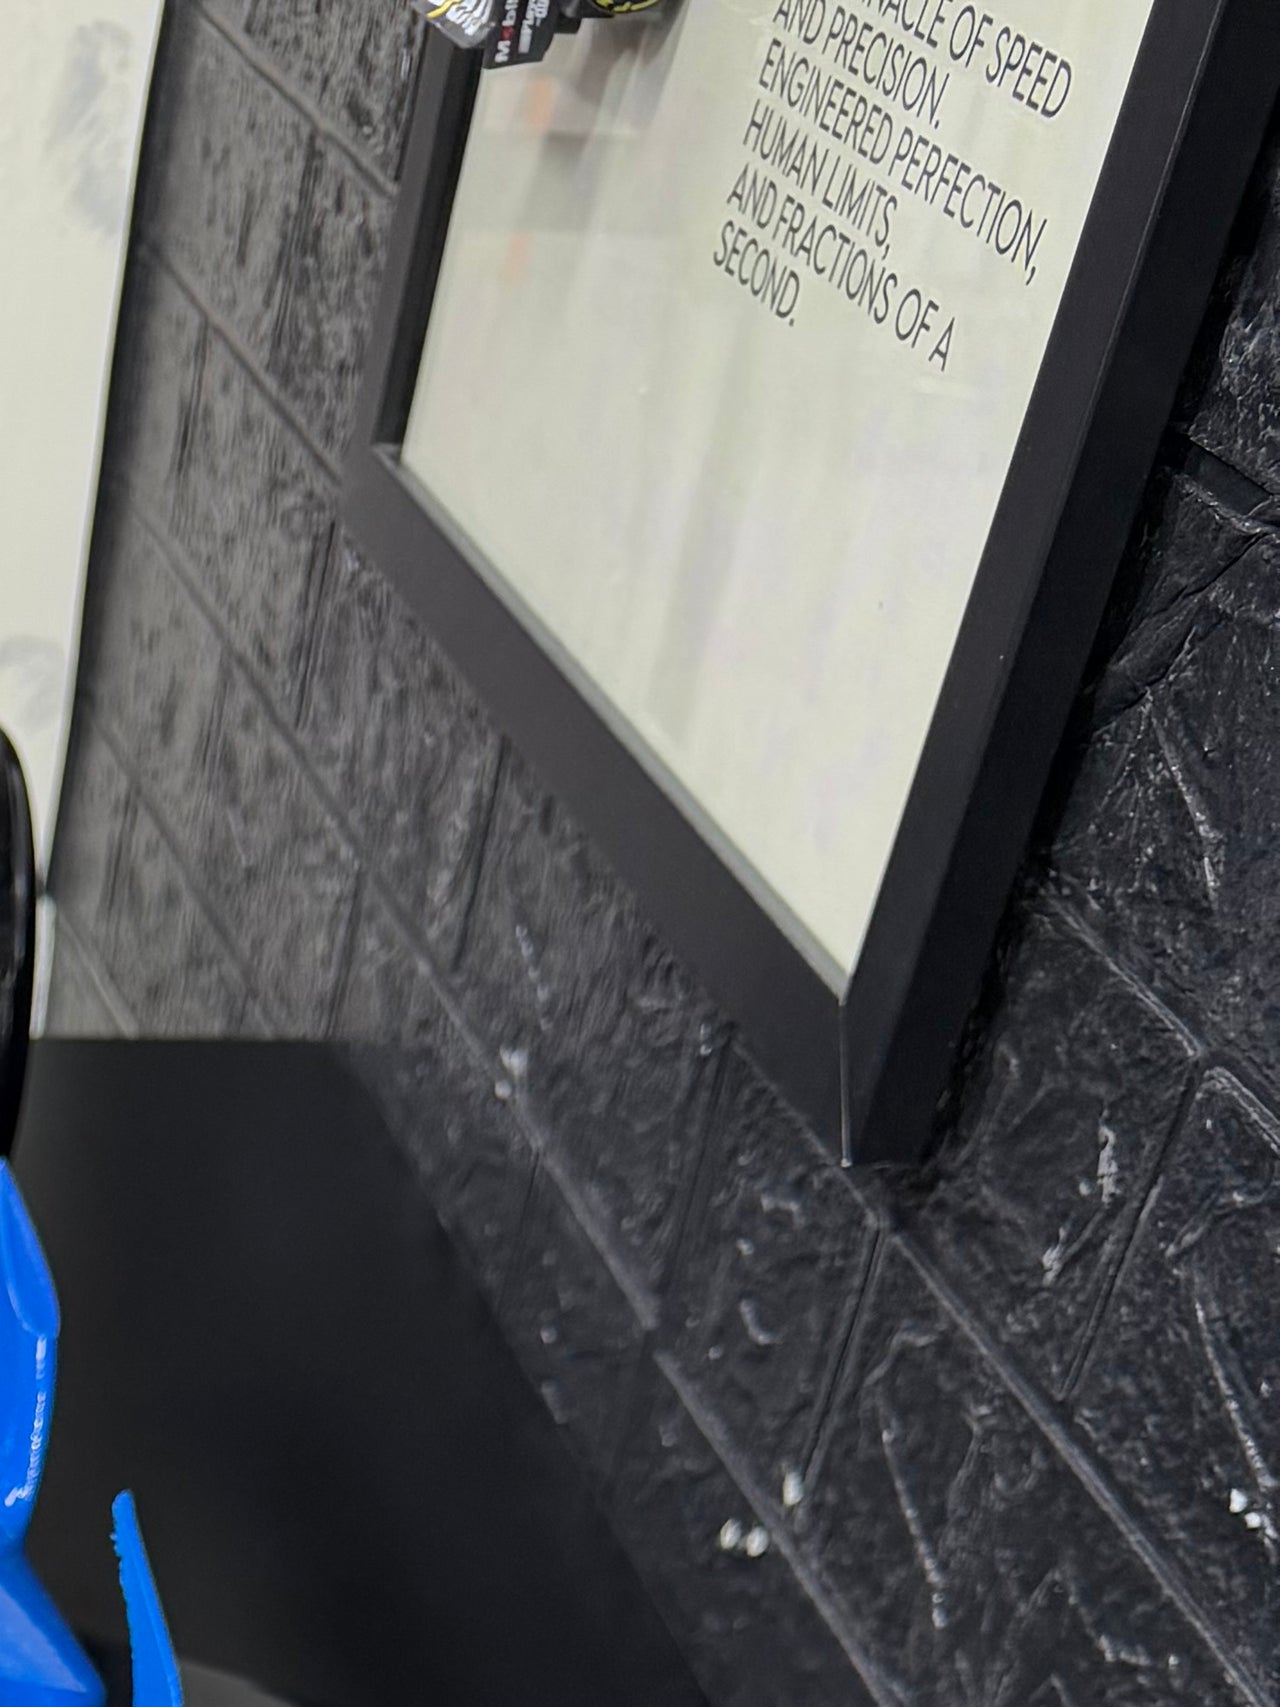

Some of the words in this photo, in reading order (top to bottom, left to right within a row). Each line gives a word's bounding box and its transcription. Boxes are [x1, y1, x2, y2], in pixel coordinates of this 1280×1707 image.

[822, 8, 951, 129] PRECISION.
[949, 5, 994, 67] OF
[986, 26, 1073, 118] SPEED
[742, 99, 829, 196] HUMAN
[822, 156, 898, 260] LIMITS,
[758, 38, 894, 165] ENGINEERED
[887, 127, 1048, 286] PERFECTION,
[713, 220, 800, 327] SECOND.
[726, 163, 779, 229] AND
[771, 195, 898, 324] FRACTIONS
[894, 288, 940, 348] OF
[927, 316, 956, 372] A
